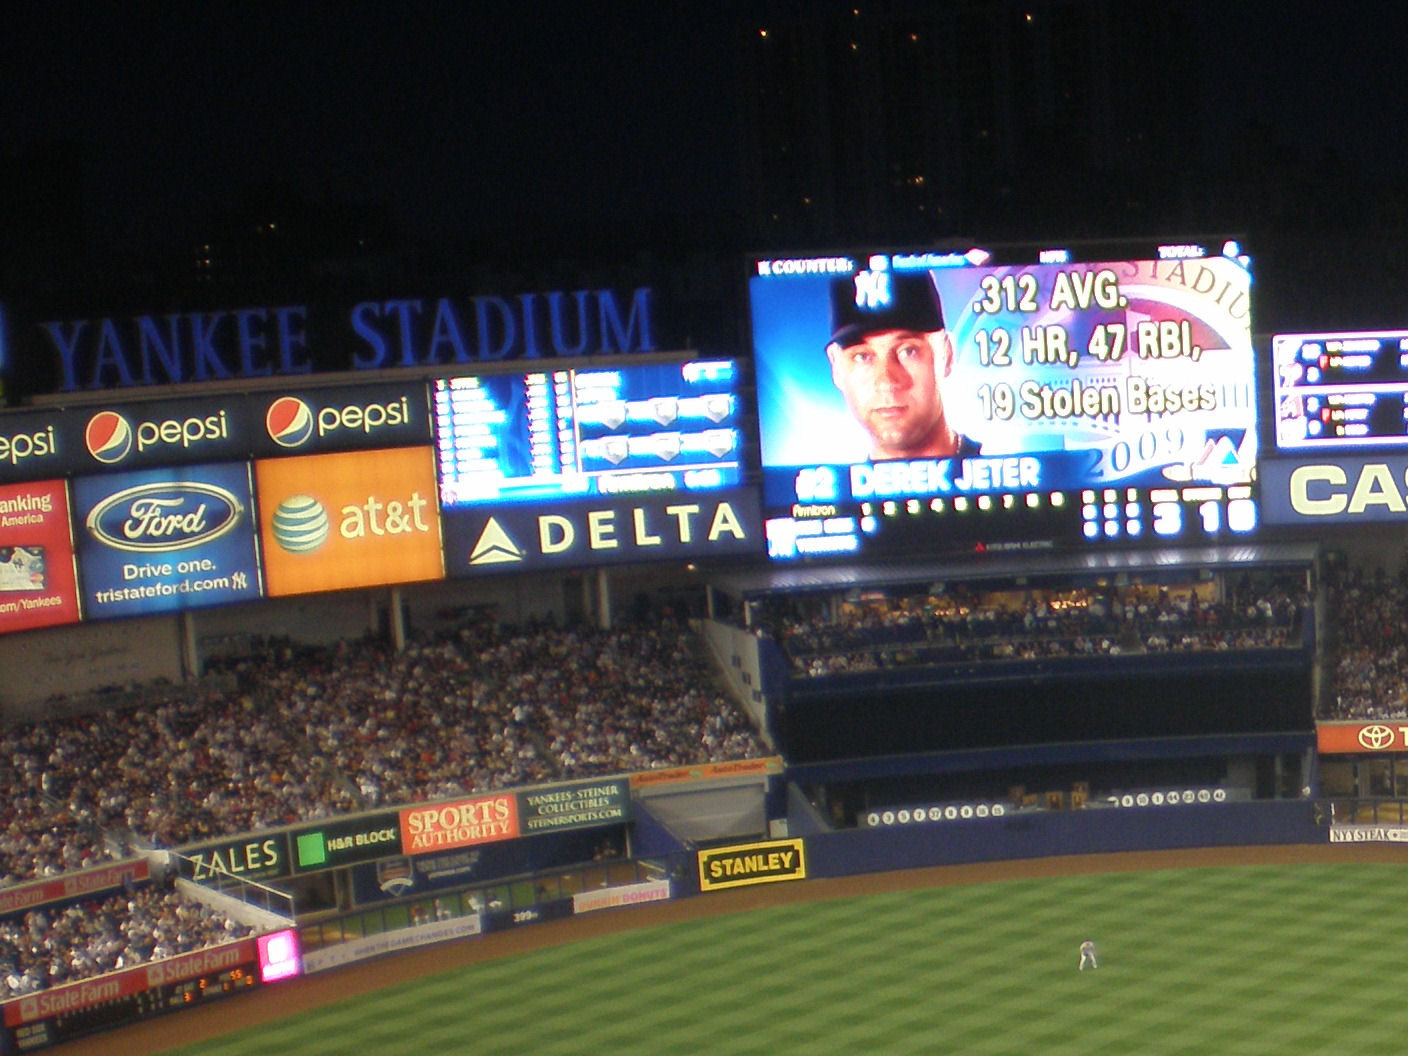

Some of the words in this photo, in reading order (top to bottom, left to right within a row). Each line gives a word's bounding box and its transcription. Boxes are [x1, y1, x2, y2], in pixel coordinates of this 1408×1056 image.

[973, 273, 1038, 314] .312
[1051, 269, 1128, 311] AVG.
[45, 306, 308, 393] YANKEE
[350, 288, 653, 369] STADIUM
[974, 327, 1012, 368] 12
[1022, 325, 1081, 369] HR,
[1087, 322, 1126, 362] 47
[1137, 319, 1202, 362] RBI,
[318, 396, 410, 437] pepsi
[977, 381, 1016, 421] 19
[1020, 378, 1121, 418] Stolen
[1126, 375, 1218, 414] Bases
[0, 426, 56, 465] epsi
[137, 410, 228, 452] pepsi
[851, 461, 950, 497] DEREK
[955, 456, 1040, 490] JETER
[0, 493, 52, 516] anking
[2, 513, 45, 528] America
[123, 497, 207, 539] Ford
[340, 491, 430, 540] at&t
[1199, 501, 1219, 532] 1
[538, 502, 746, 553] DELTA
[123, 561, 173, 580] Drive
[177, 558, 216, 575] one.
[0, 595, 62, 614] om/Yankees
[96, 576, 229, 603] tristateford.com
[408, 798, 510, 836] SPORTS
[527, 808, 622, 829] STEINERSPORTS.COM
[538, 797, 609, 815] COLLECTIBLES
[327, 838, 354, 852] H&R
[356, 828, 396, 850] BLOCK
[411, 820, 511, 849] AUTHORITY
[189, 840, 278, 881] ZALES
[710, 851, 794, 878] STANLEY
[622, 887, 668, 903] DONUTS
[166, 958, 202, 981] State
[203, 948, 240, 971] Farm
[39, 985, 80, 1016] State
[81, 979, 119, 1003] Farm
